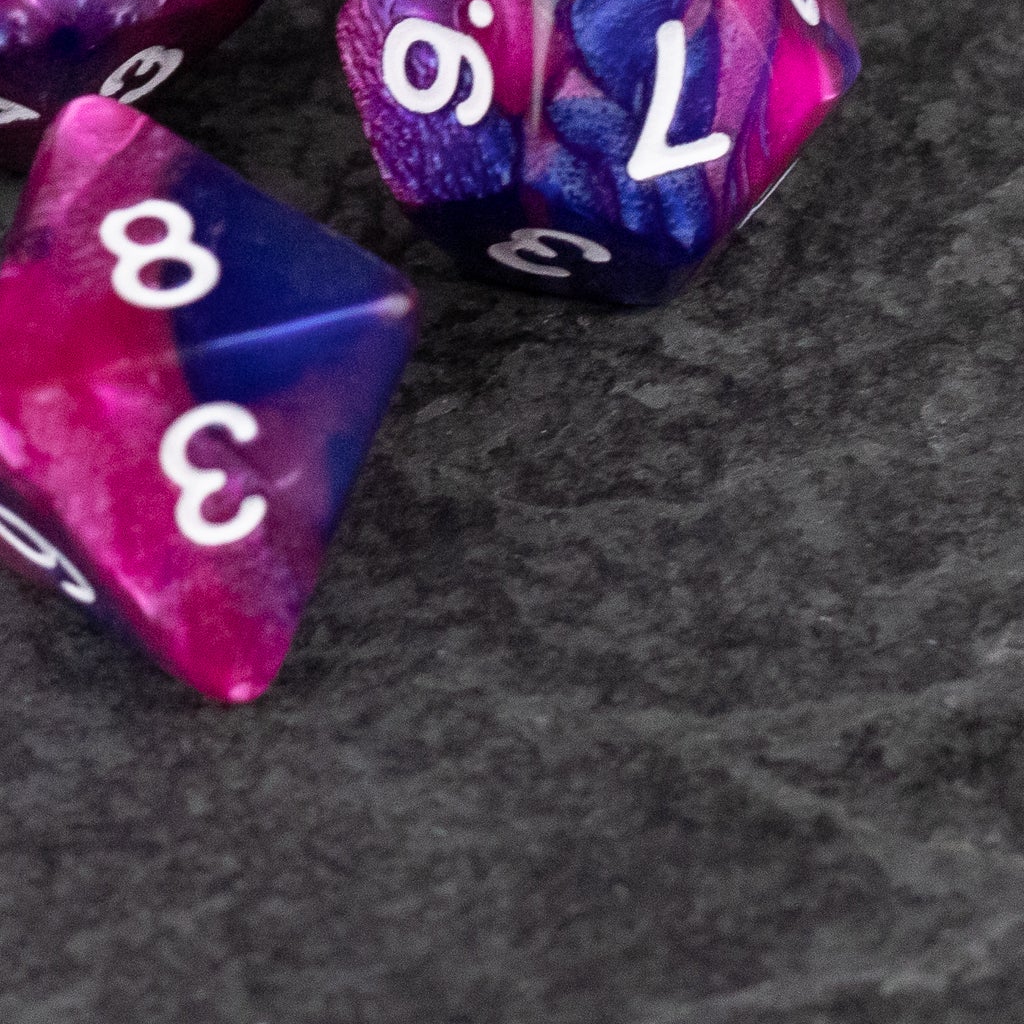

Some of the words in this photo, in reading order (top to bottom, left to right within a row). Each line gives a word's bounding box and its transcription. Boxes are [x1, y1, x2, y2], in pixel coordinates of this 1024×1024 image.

[626, 19, 732, 182] 7
[98, 198, 221, 309] 8
[487, 228, 613, 278] 3
[159, 403, 267, 547] 3
